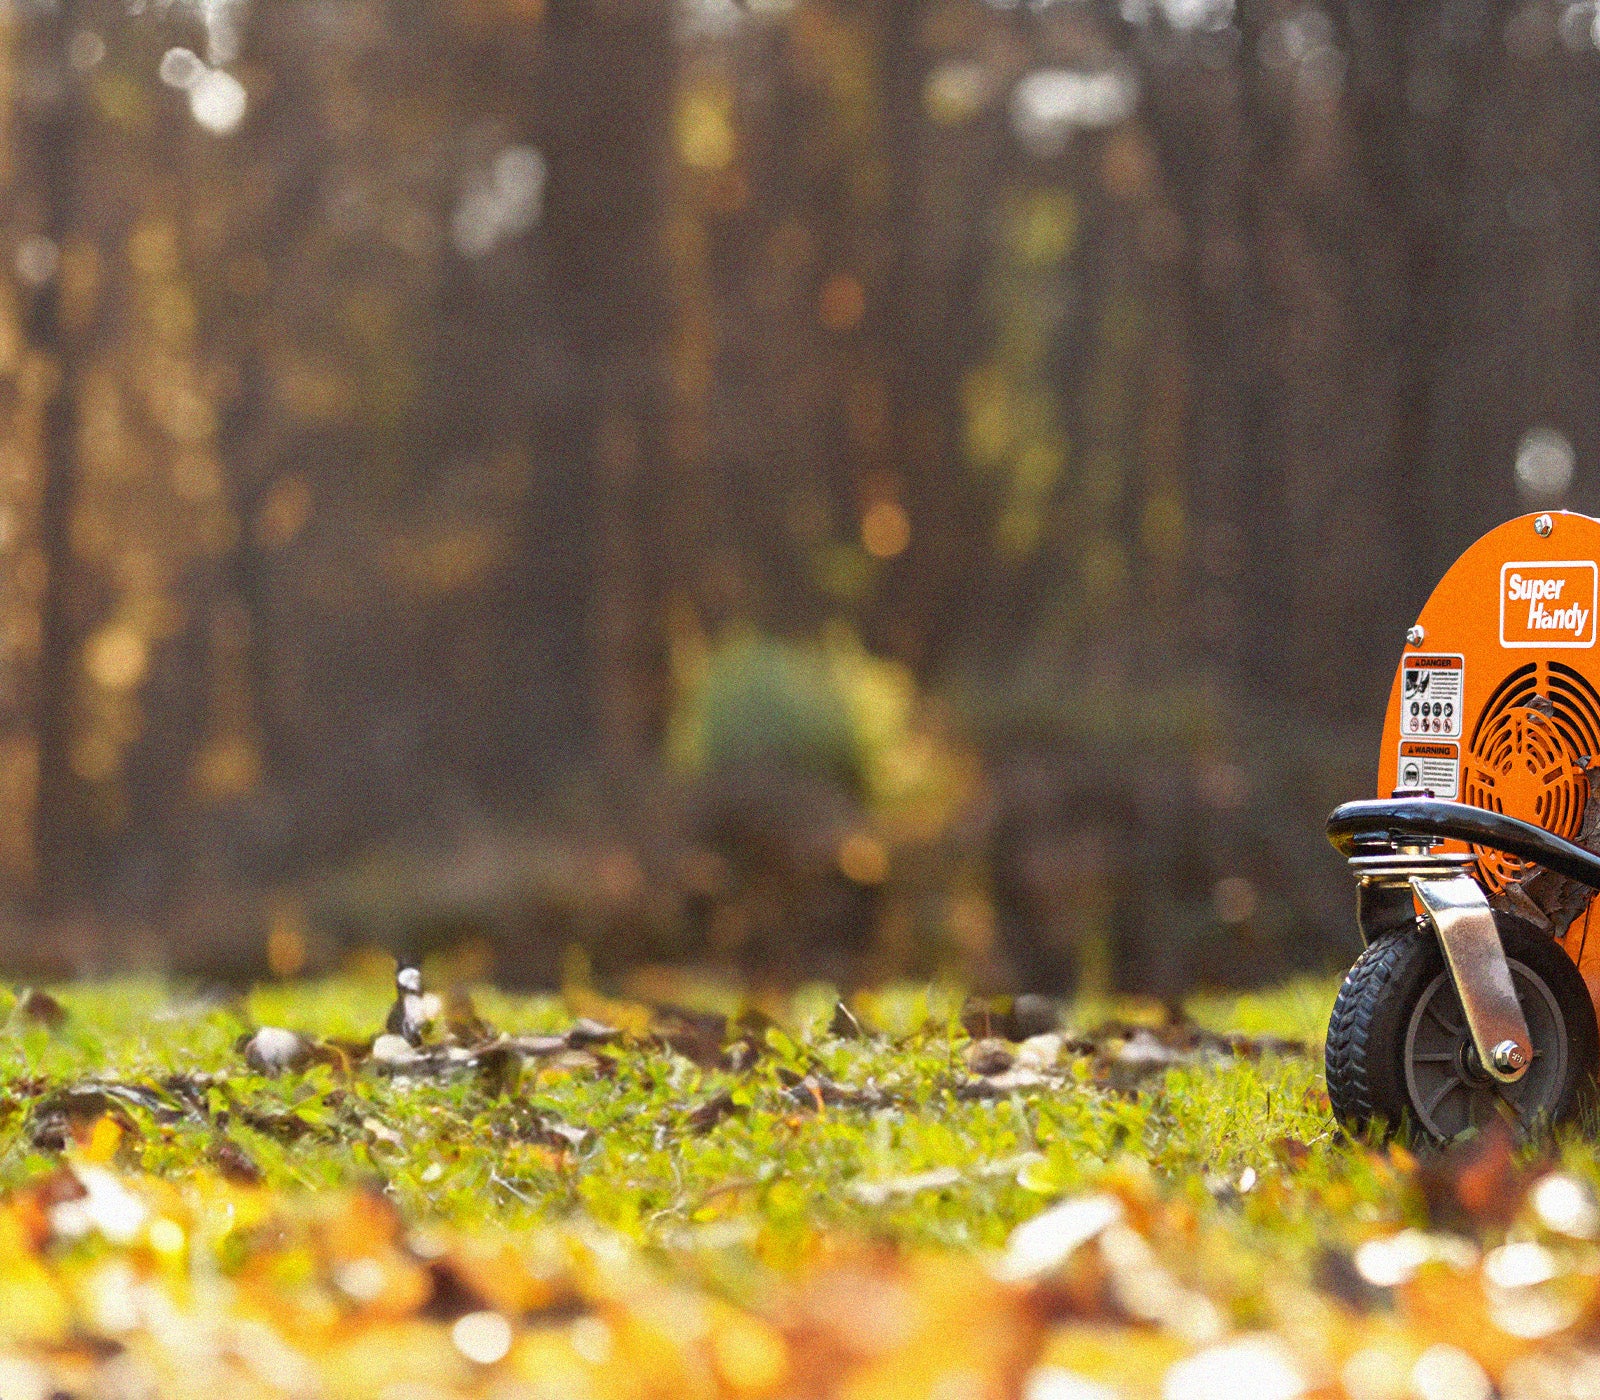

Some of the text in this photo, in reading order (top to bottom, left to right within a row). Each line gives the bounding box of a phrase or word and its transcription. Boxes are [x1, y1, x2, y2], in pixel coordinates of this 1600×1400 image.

[1508, 573, 1566, 602] Super
[1526, 601, 1589, 637] Handy
[1420, 659, 1452, 667] DANGER
[1415, 746, 1451, 755] WARNING
